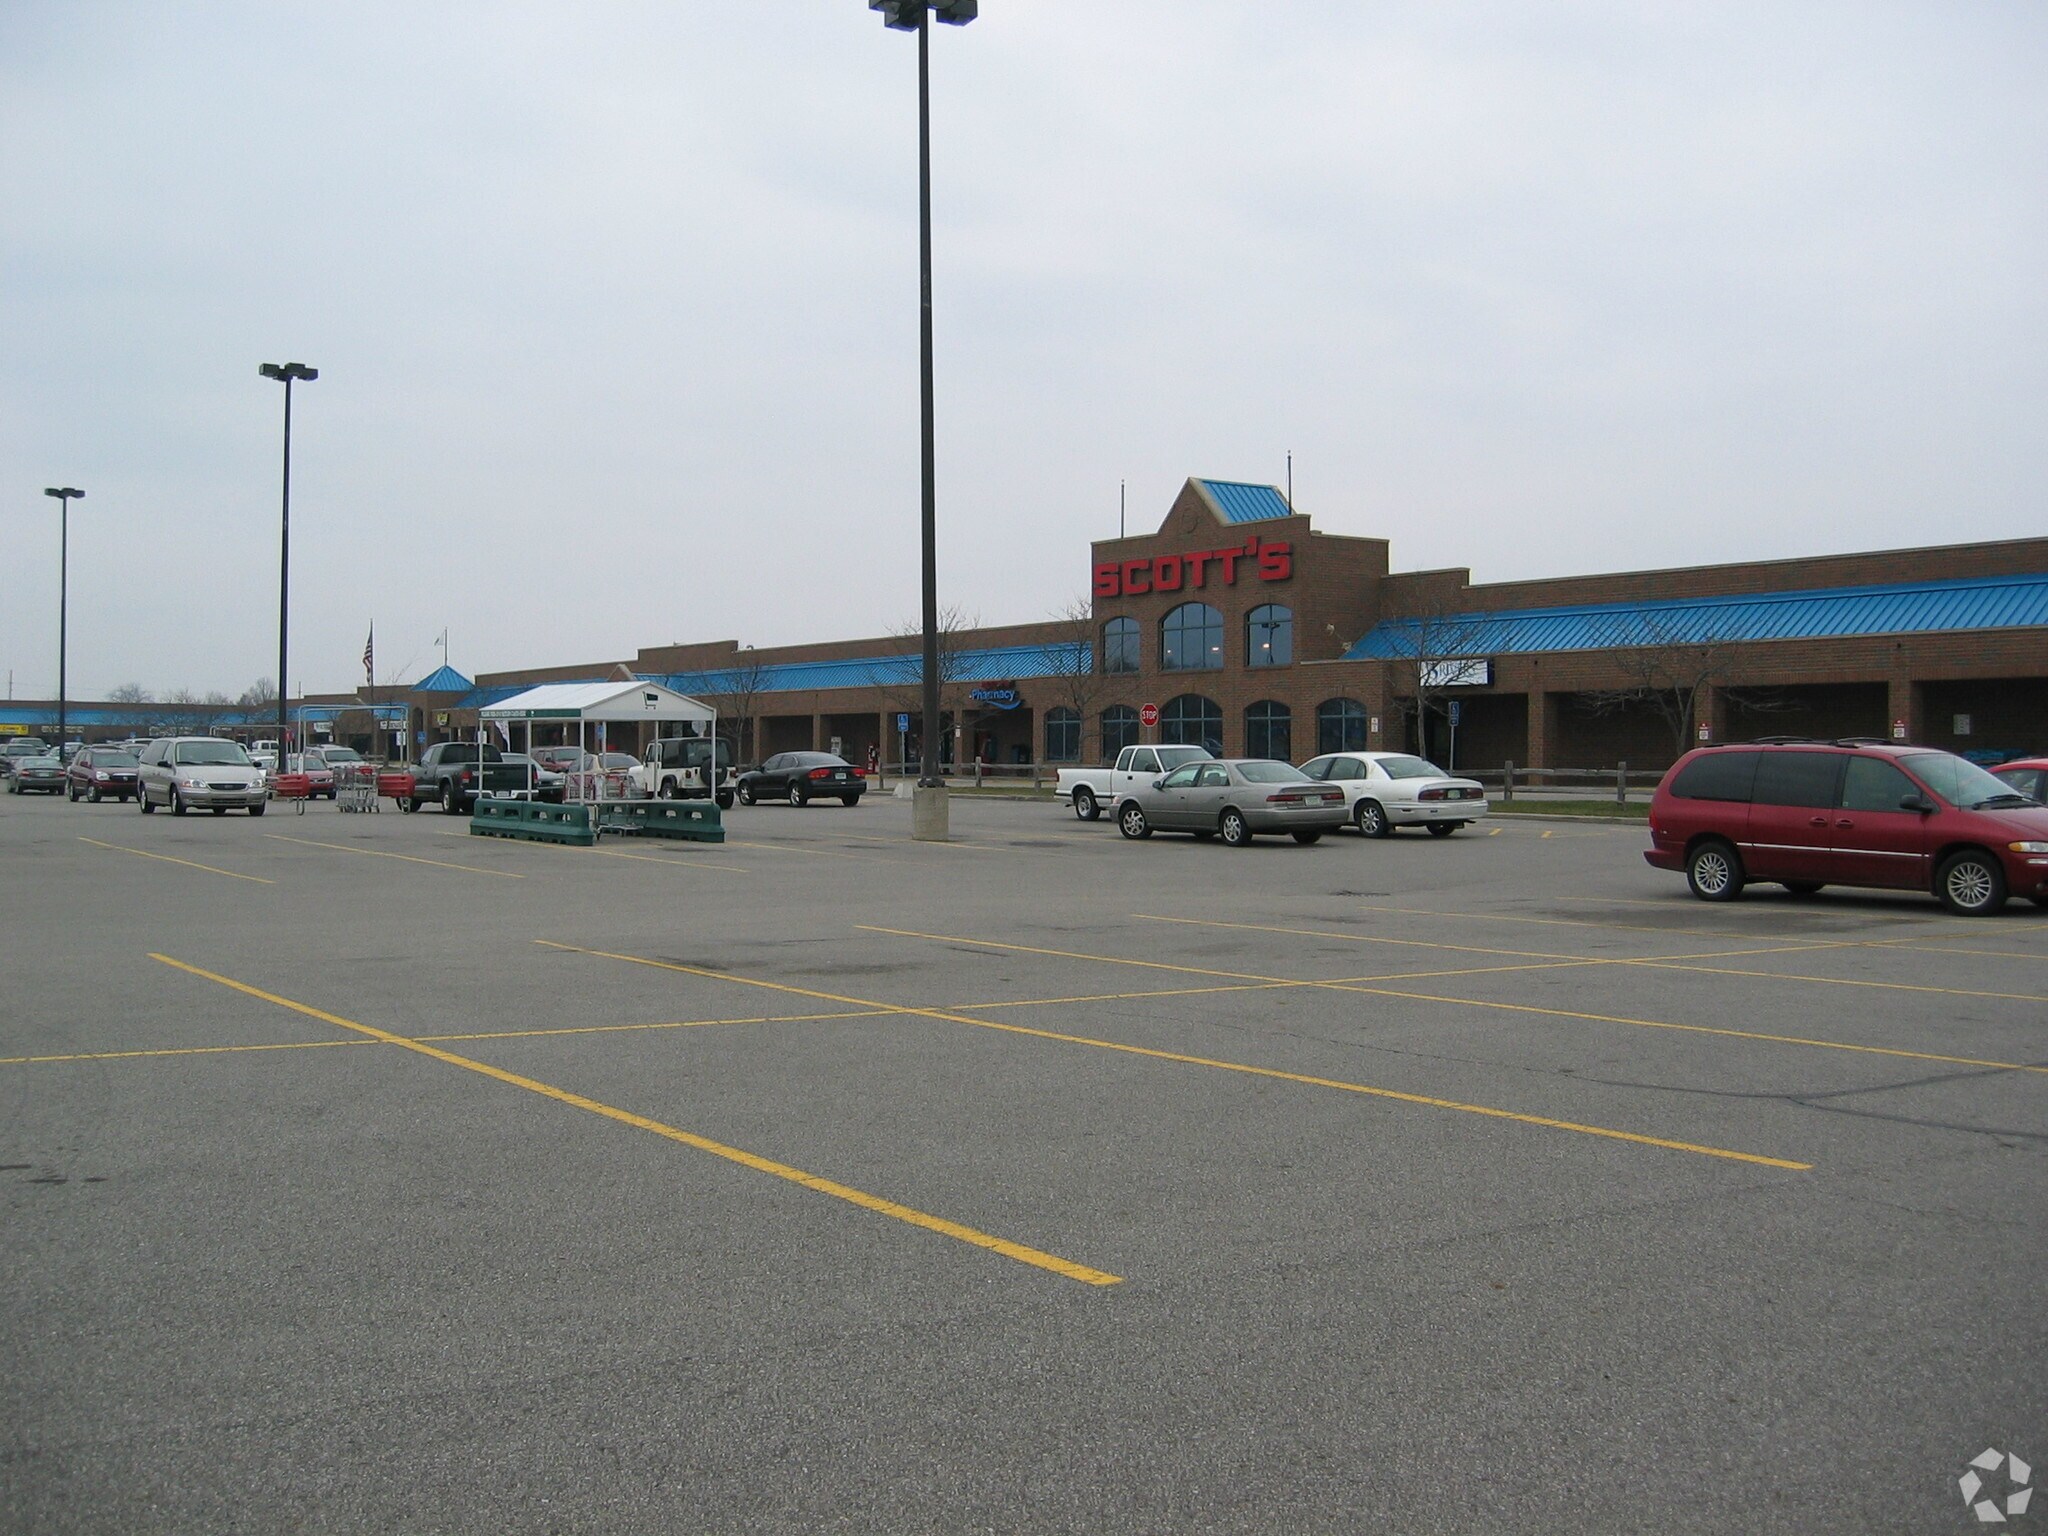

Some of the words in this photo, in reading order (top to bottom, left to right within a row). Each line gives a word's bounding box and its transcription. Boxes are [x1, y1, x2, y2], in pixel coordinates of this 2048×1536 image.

[1094, 536, 1290, 598] SCOTT'S
[971, 689, 1015, 701] Pharmacy
[1142, 711, 1156, 720] STOP
